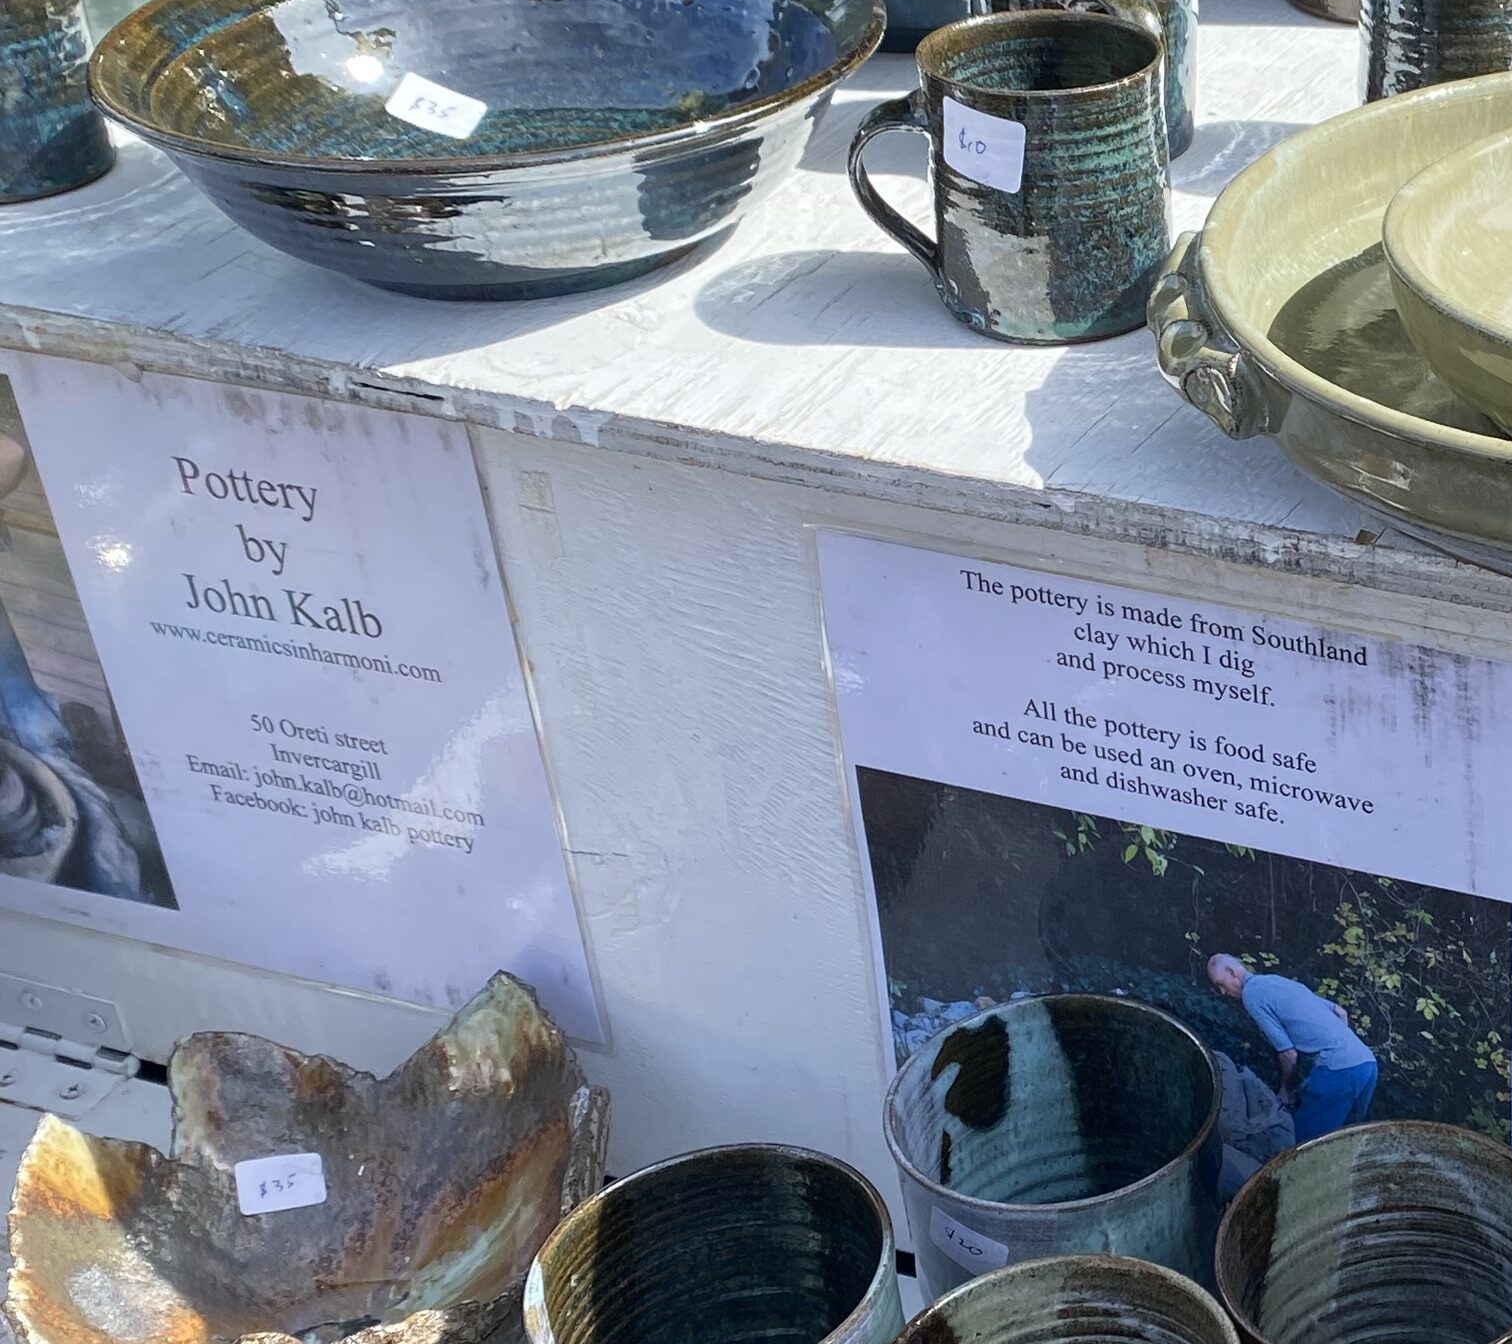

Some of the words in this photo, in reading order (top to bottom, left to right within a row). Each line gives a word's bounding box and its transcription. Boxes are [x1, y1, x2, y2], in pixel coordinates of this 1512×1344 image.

[958, 127, 987, 155] $10
[171, 456, 317, 522] Pottery
[234, 523, 288, 575] by
[181, 572, 279, 622] John
[282, 588, 383, 638] Kalb
[960, 569, 1004, 596] The
[1010, 583, 1088, 616] pottery
[1096, 594, 1115, 617] is
[1121, 605, 1183, 630] made
[1190, 612, 1244, 642] from
[1251, 624, 1368, 666] Southland
[149, 620, 443, 683] www.ceramicsinharmoni.com
[1056, 652, 1096, 672] and
[1103, 659, 1186, 689] process
[1192, 677, 1275, 707] myself.
[1074, 622, 1120, 651] clay
[1127, 634, 1195, 663] which
[1201, 645, 1212, 665] I
[1219, 649, 1255, 678] dig
[250, 714, 274, 735] 50
[279, 717, 329, 745] Oreti
[335, 732, 389, 755] street
[270, 743, 383, 782] Invercargill
[1023, 698, 1057, 722] All
[1064, 706, 1098, 729] the
[1104, 718, 1182, 749] pottery
[1189, 729, 1207, 752] is
[1215, 735, 1265, 763] food
[1272, 752, 1317, 774] safe
[185, 753, 249, 782] Email:
[254, 765, 486, 827] john.kalb@hotmail.com
[972, 720, 1011, 740] and
[1017, 729, 1054, 749] can
[1060, 733, 1087, 755] be
[1094, 744, 1143, 767] used
[1150, 756, 1176, 774] an
[1183, 762, 1243, 790] oven,
[1250, 775, 1375, 814] microwave
[1060, 765, 1099, 785] and
[1106, 771, 1229, 812] dishwasher
[1234, 801, 1285, 825] safe.
[209, 783, 309, 818] Facebook:
[312, 802, 356, 828] john
[360, 811, 401, 837] kalb
[406, 825, 475, 855] pottery
[259, 1172, 297, 1200] $35
